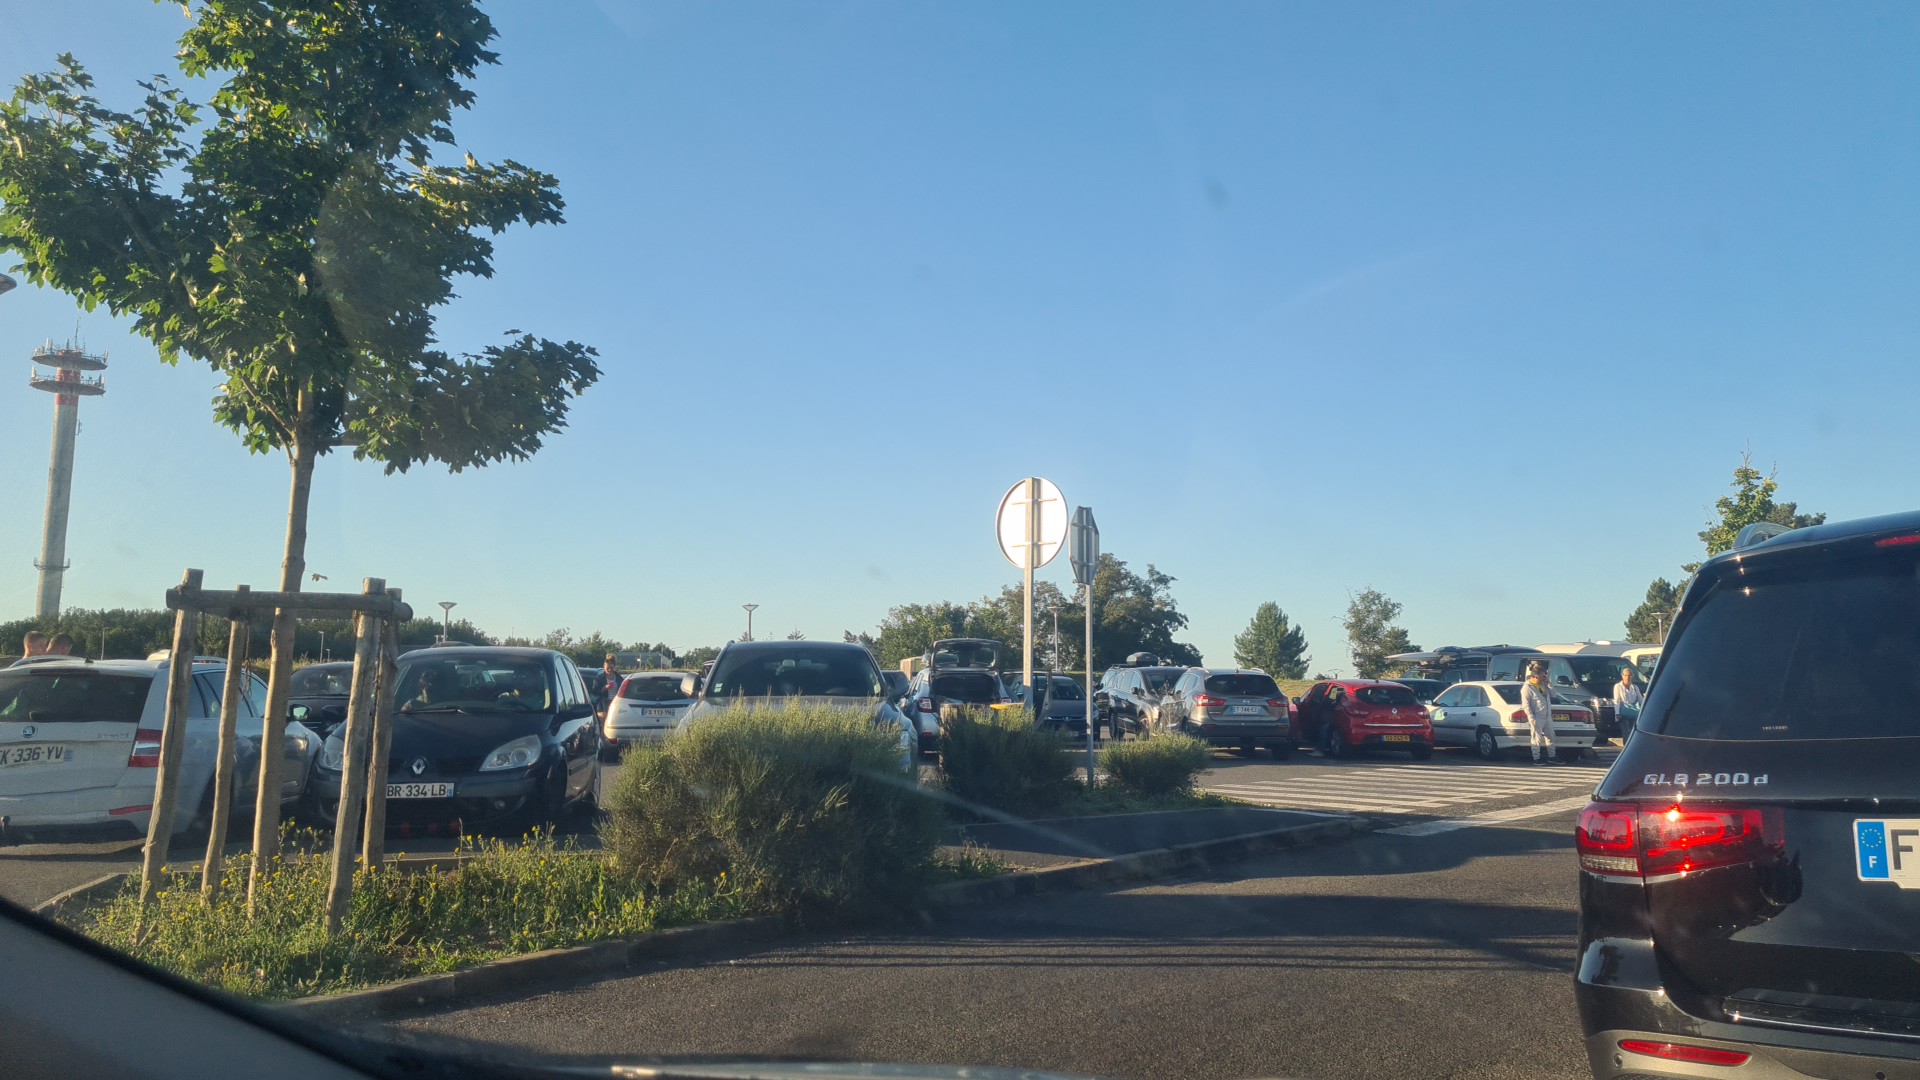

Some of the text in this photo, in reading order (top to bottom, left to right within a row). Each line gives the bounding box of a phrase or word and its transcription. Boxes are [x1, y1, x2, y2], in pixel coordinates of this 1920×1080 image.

[1643, 772, 1769, 786] GLB 200 d
[387, 785, 447, 797] BR-334-LB
[1890, 829, 1919, 870] F
[1868, 855, 1878, 868] F
